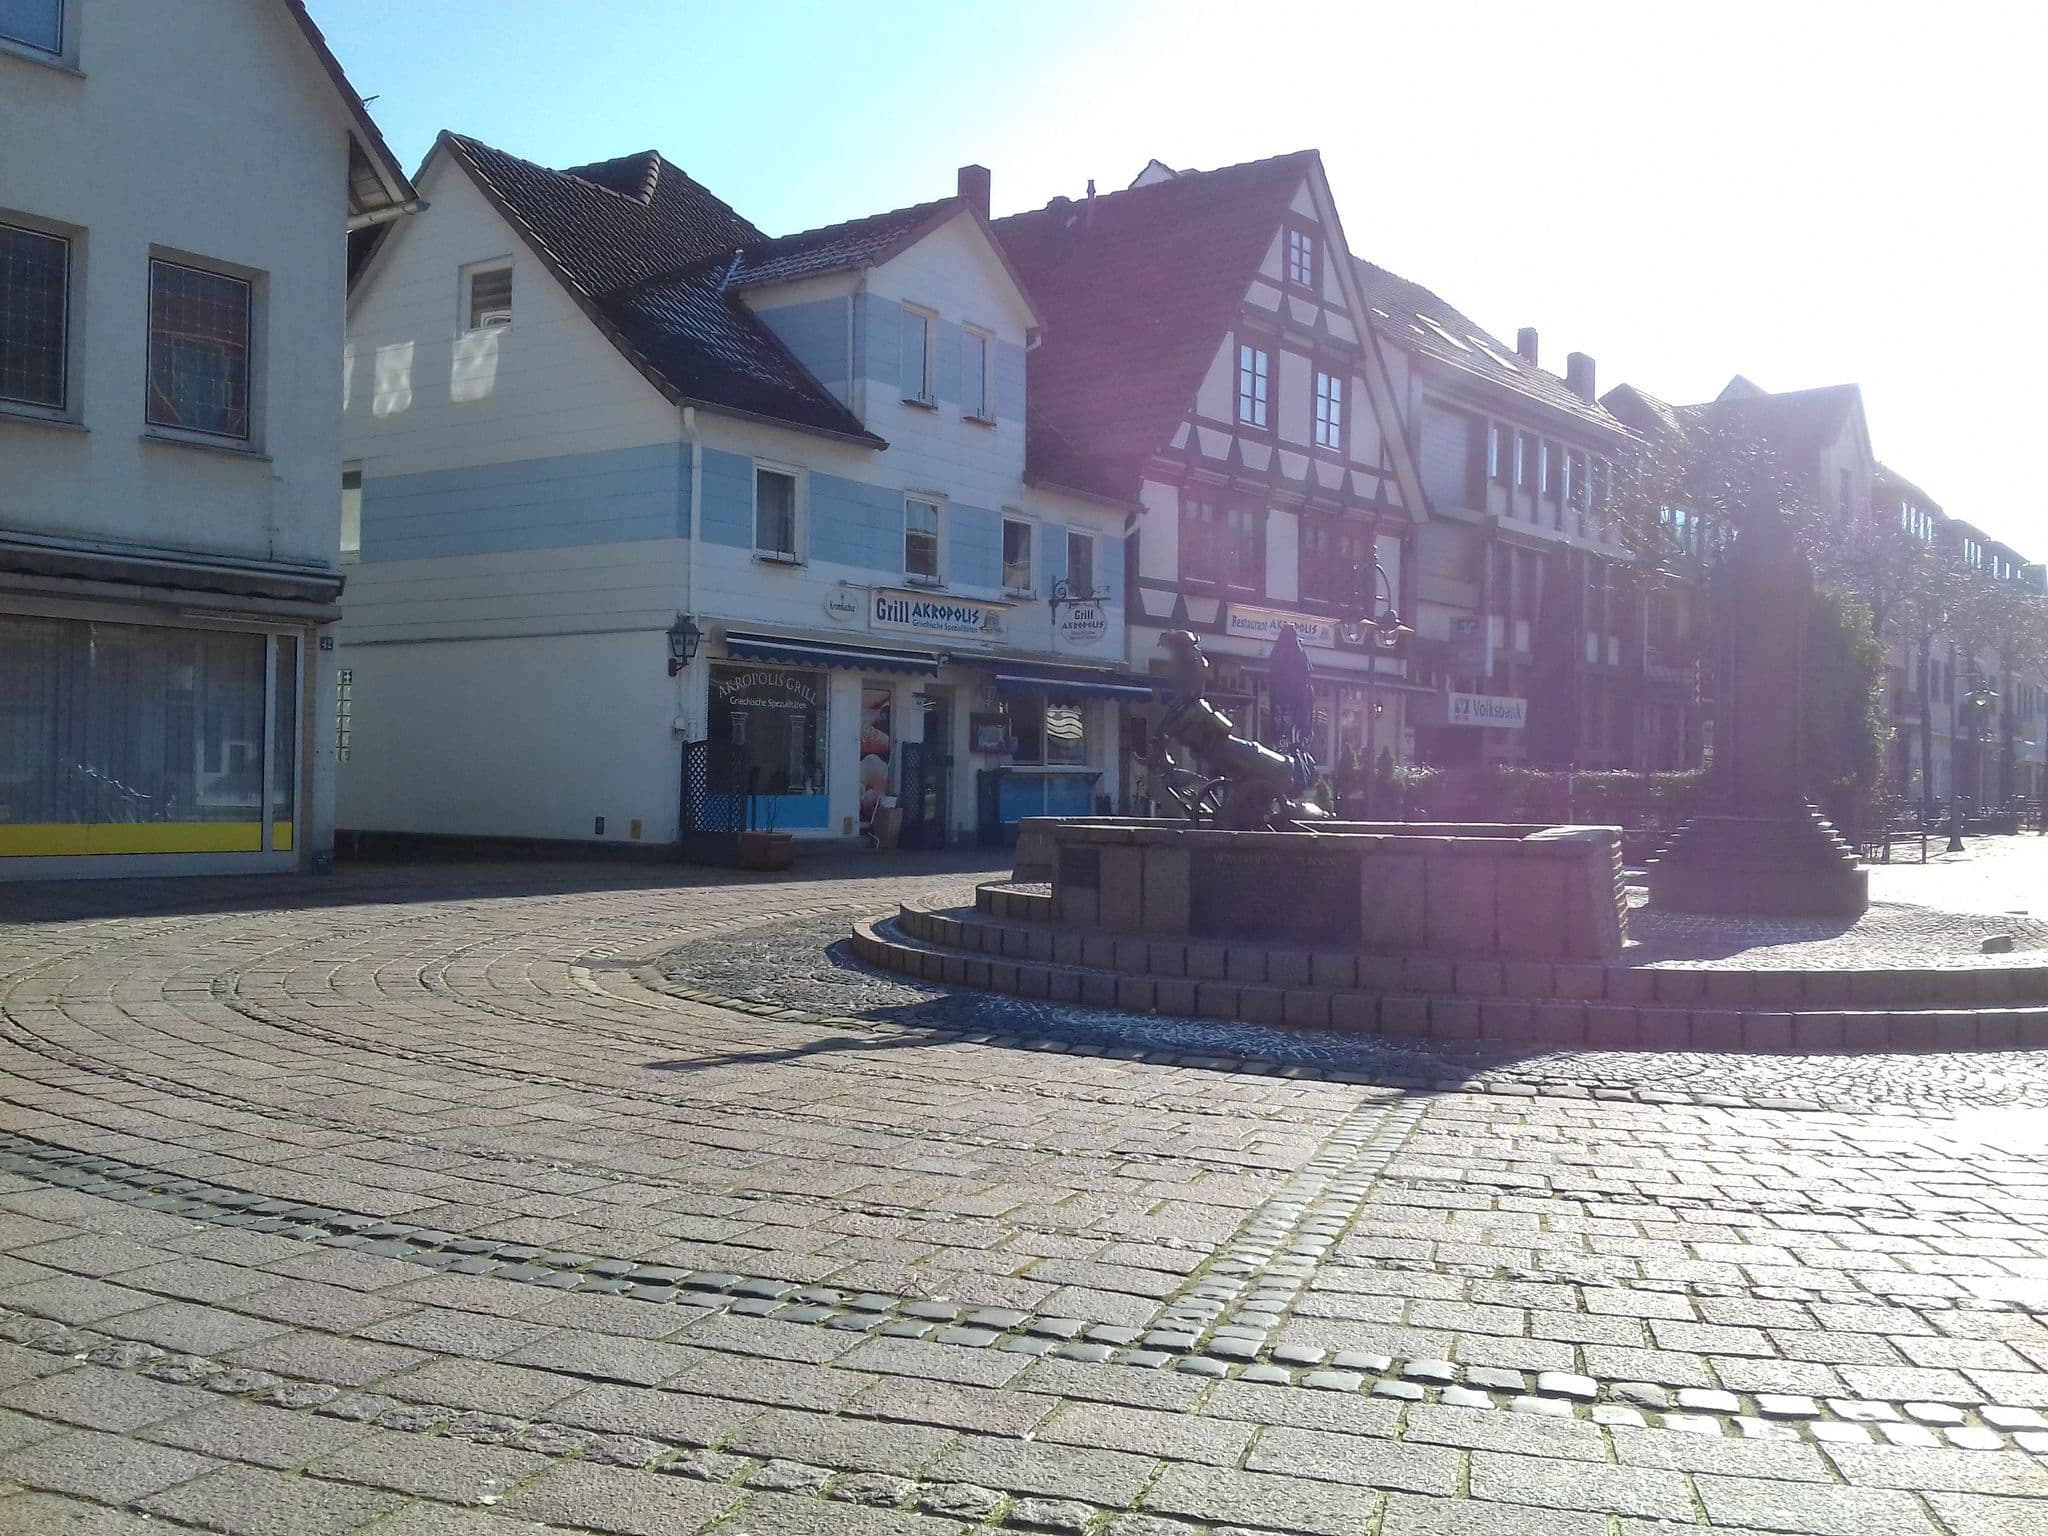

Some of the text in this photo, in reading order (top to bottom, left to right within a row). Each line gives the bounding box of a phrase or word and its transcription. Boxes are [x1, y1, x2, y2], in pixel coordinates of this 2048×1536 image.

[877, 598, 979, 623] Grill AKROPOLIS
[1074, 609, 1093, 620] Grill
[1061, 621, 1105, 629] AKROPOLIS
[1231, 614, 1267, 631] Restaurant
[1269, 619, 1317, 634] AKPOLIS
[720, 672, 816, 706] AKROPOLIS GRILL
[729, 696, 767, 707] Griechische
[1472, 699, 1522, 720] Volksbank
